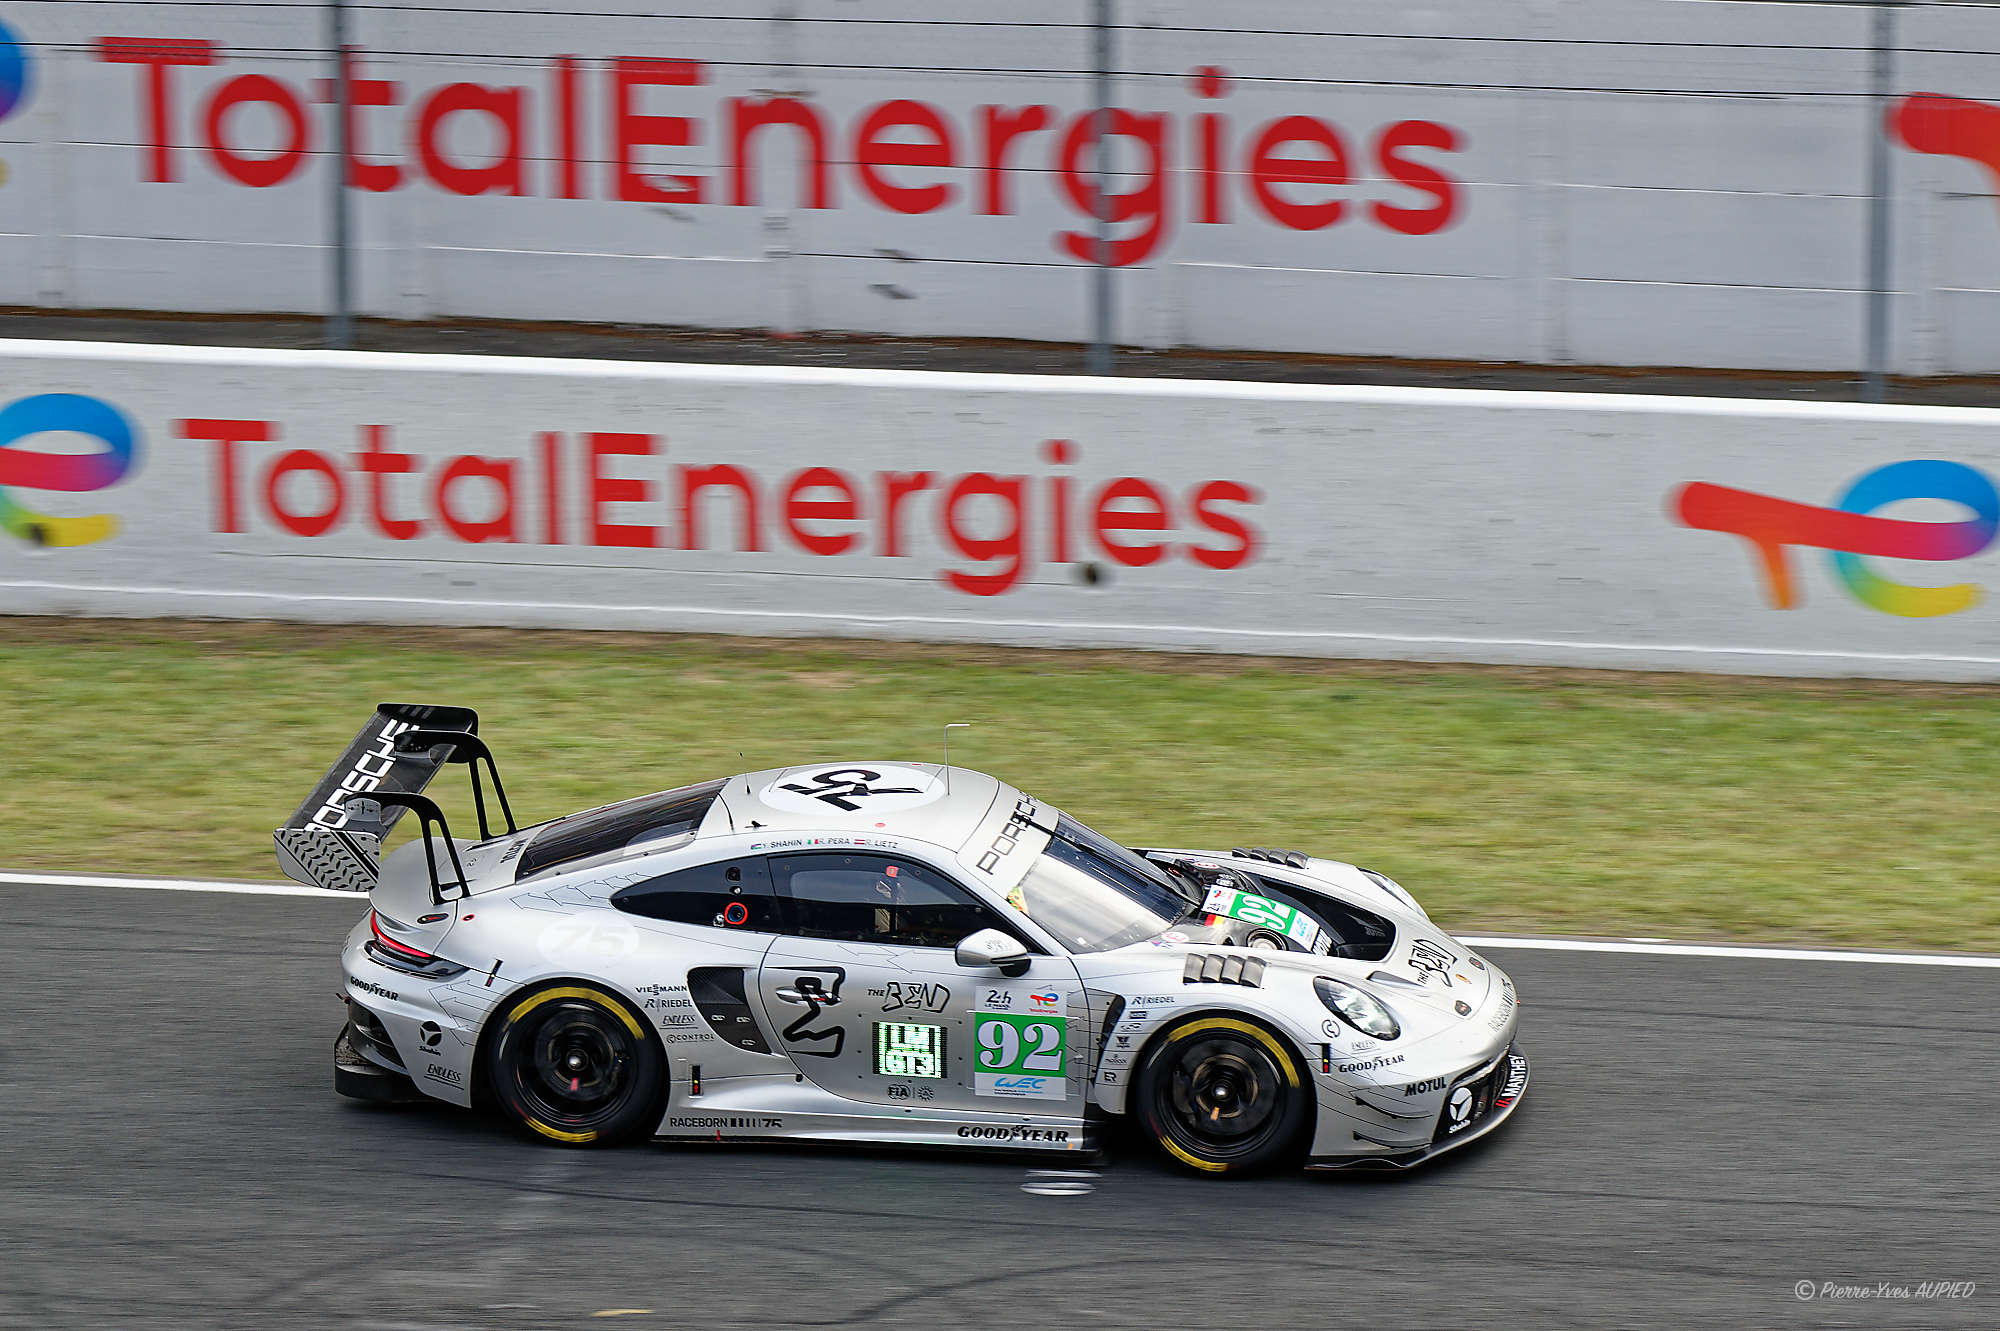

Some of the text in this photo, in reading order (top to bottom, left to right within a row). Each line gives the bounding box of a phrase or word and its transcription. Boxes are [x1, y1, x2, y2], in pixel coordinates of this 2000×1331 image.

[92, 36, 1471, 267] TotalEnergies
[173, 418, 1265, 596] TotalEnergies
[771, 840, 802, 849] SHAHIN
[828, 837, 850, 845] PERA
[1237, 895, 1291, 930] 92
[350, 976, 399, 1001] GOODYEAR
[868, 989, 885, 997] THE
[661, 999, 693, 1008] RIEDEL
[977, 1020, 1062, 1071] 92
[1339, 1054, 1405, 1073] GOODYEAR
[994, 1077, 1047, 1089] WEC
[1501, 1055, 1526, 1097] MANTHEY
[887, 1086, 909, 1098] FIA
[1404, 1077, 1447, 1097] MOTUL
[670, 1117, 783, 1128] RACEBORN 75
[957, 1124, 1070, 1142] GOODYEAR
